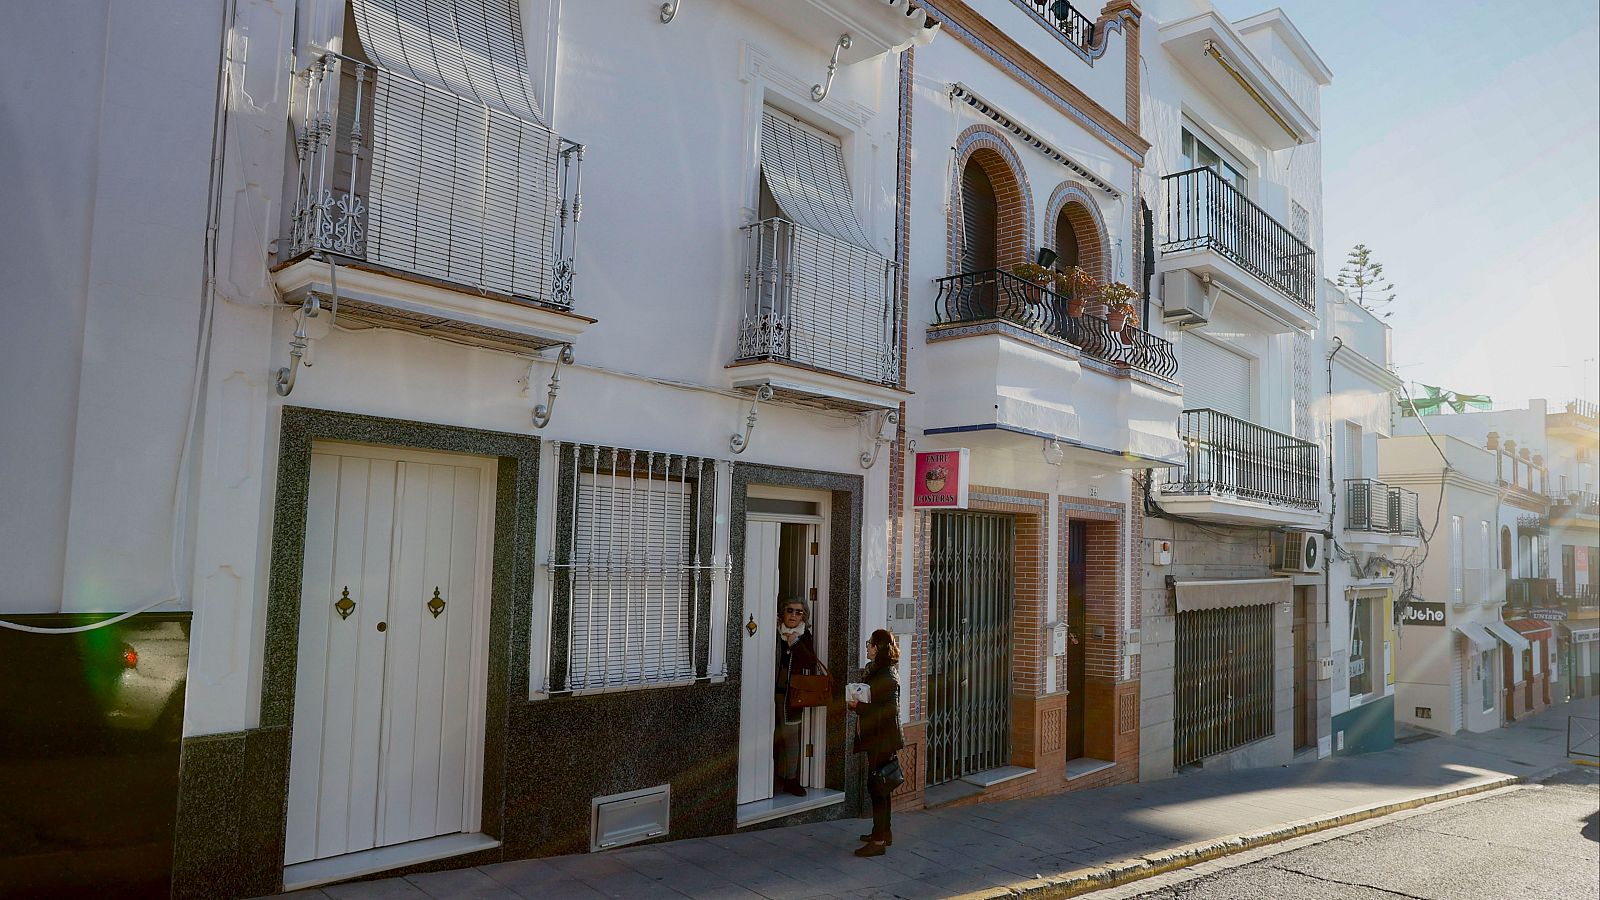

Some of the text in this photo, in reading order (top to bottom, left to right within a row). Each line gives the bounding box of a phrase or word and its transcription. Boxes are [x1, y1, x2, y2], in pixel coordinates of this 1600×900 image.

[926, 454, 949, 463] ENTRE
[917, 494, 954, 503] COSTURAS
[1401, 606, 1444, 621] ucho
